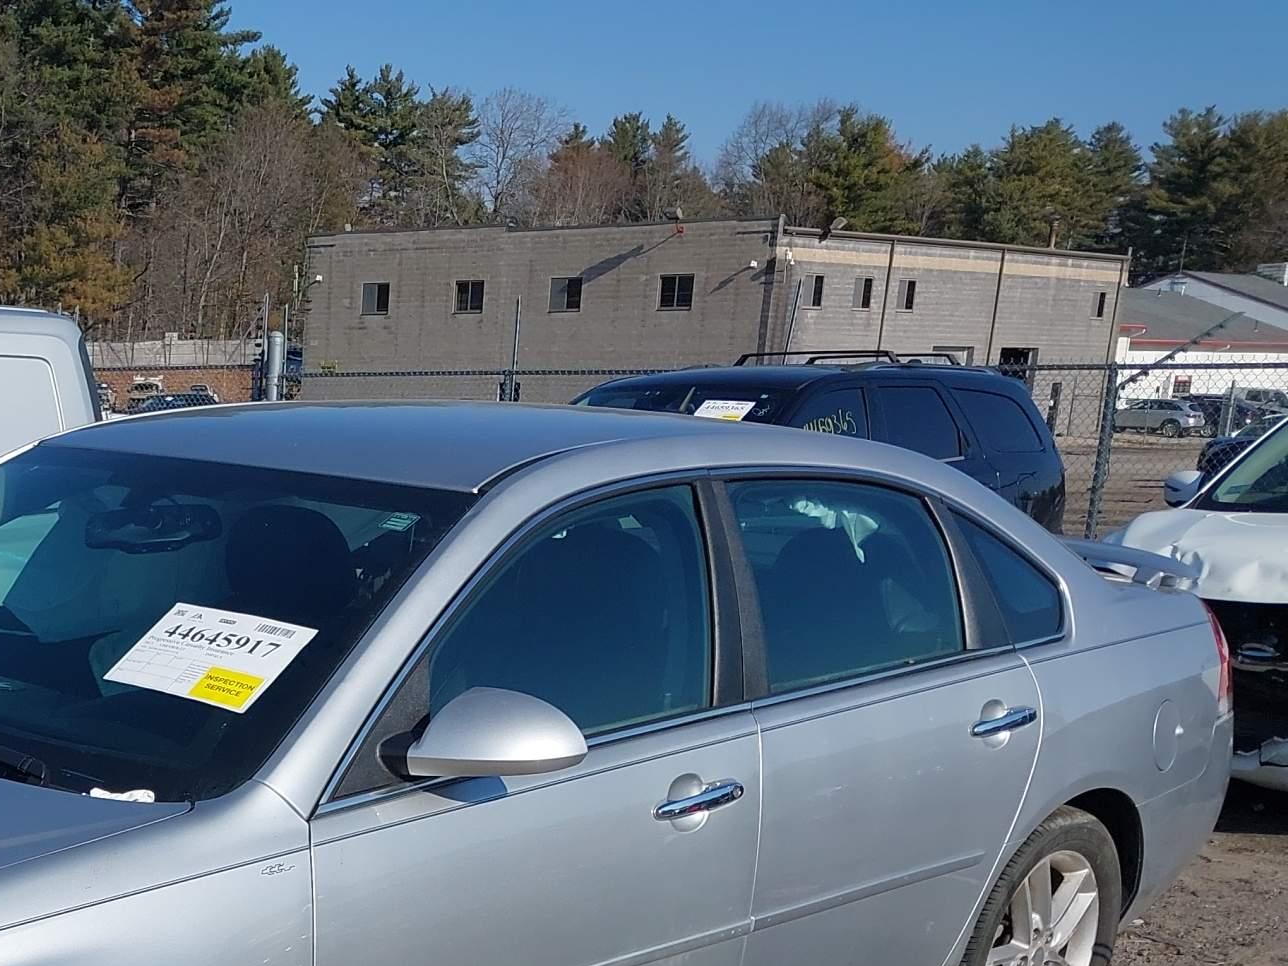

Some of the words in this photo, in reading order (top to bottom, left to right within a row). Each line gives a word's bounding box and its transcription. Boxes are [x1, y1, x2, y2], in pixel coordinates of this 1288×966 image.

[164, 623, 281, 658] 44645917
[204, 682, 242, 697] SERVICE
[205, 673, 256, 692] INSPECTION
